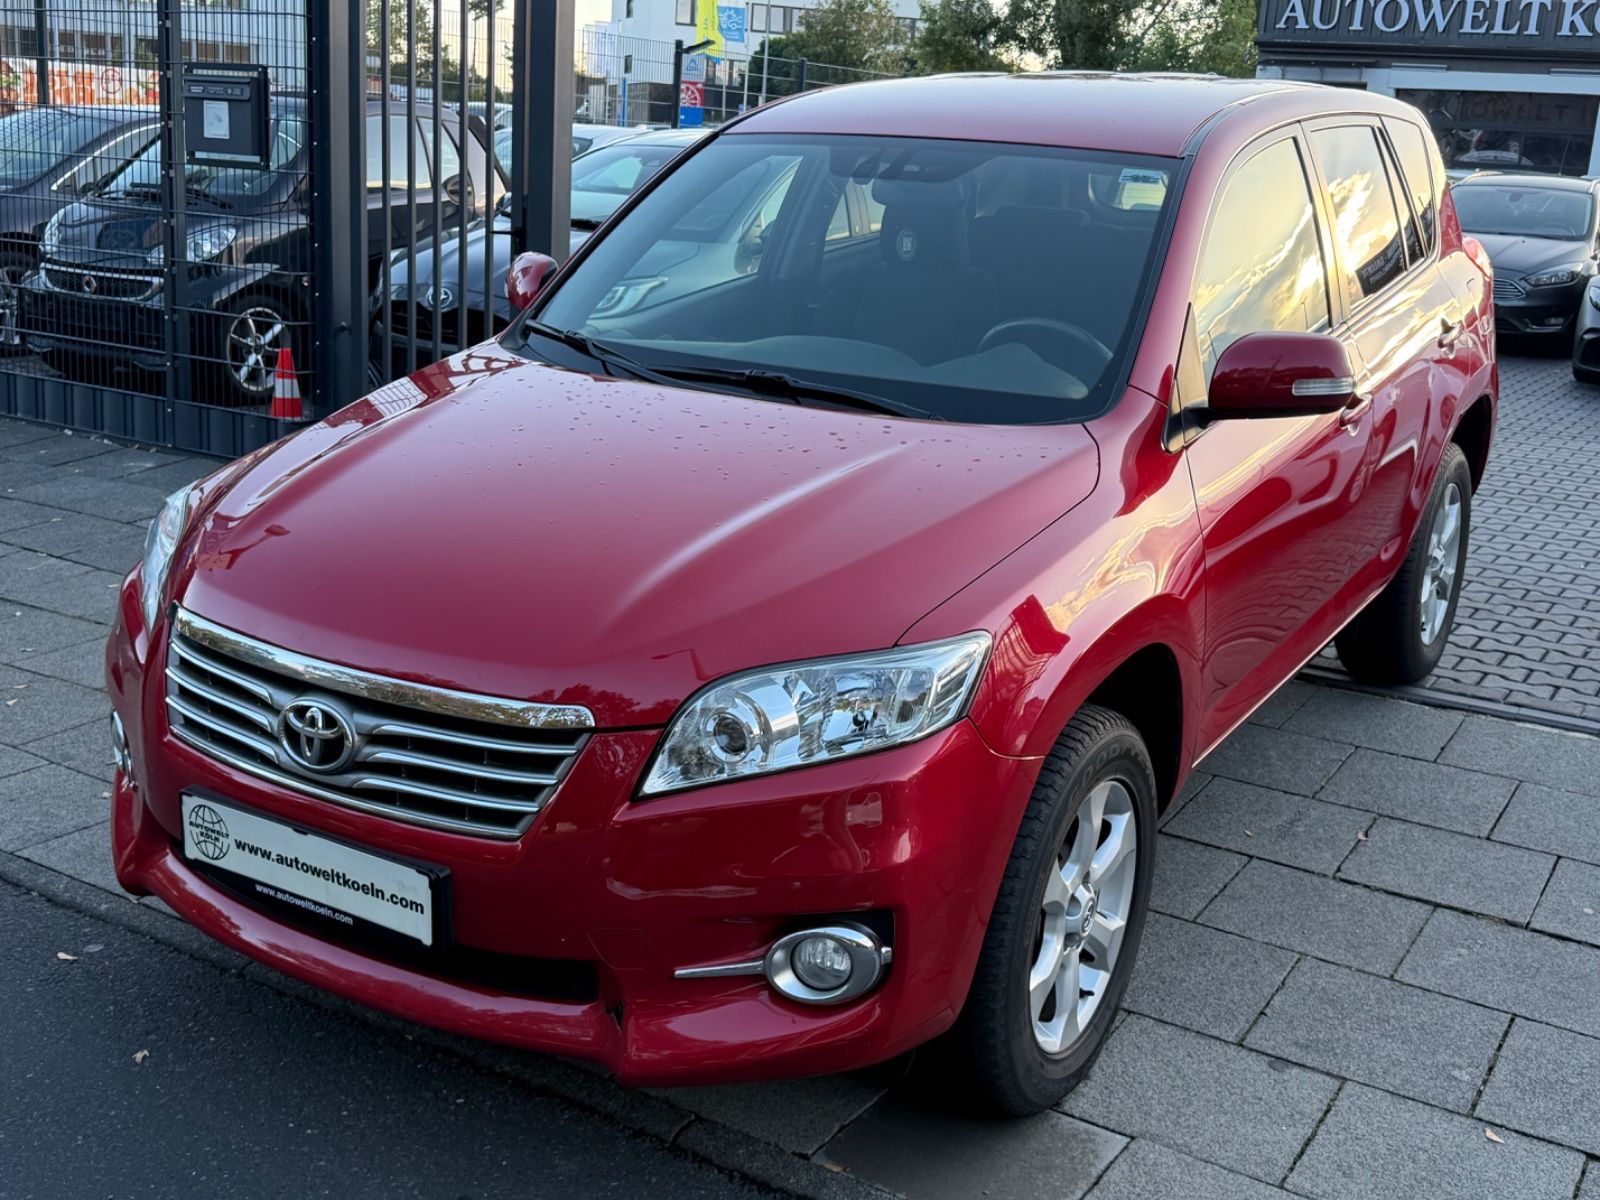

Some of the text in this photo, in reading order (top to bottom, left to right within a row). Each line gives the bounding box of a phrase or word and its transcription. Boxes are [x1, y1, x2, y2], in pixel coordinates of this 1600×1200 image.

[1275, 0, 1600, 37] AUTOWELT K
[188, 820, 230, 839] AUTOWELT
[199, 830, 220, 843] KÖLN
[234, 838, 425, 915] www.autoweltkoeln.com
[255, 883, 353, 926] www.autoweltkoeln.com
